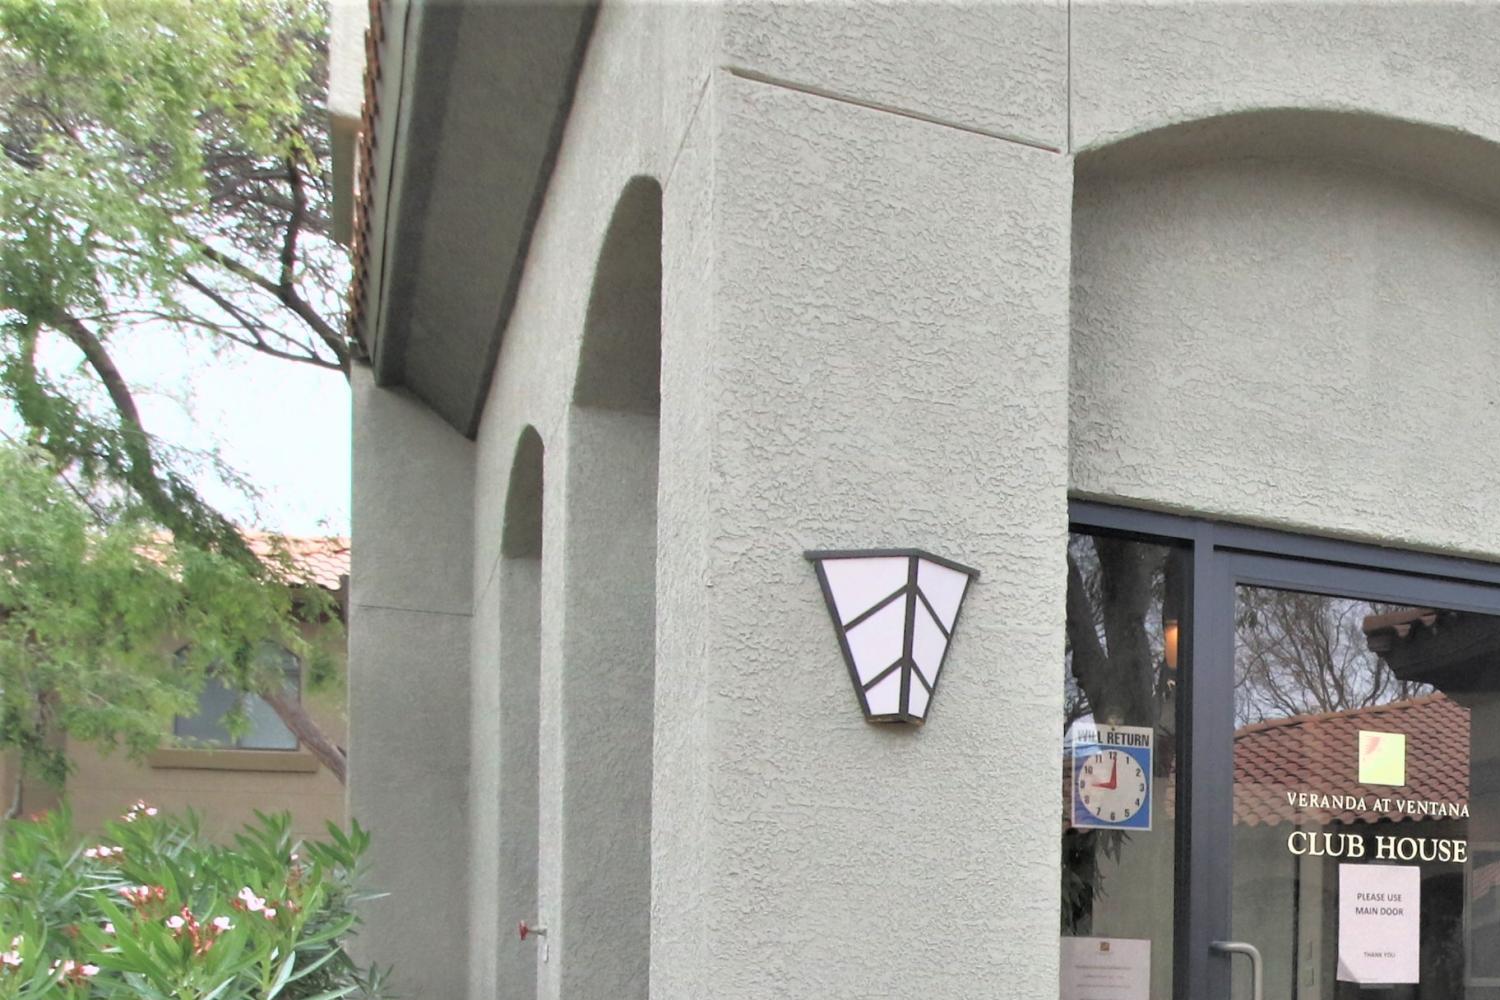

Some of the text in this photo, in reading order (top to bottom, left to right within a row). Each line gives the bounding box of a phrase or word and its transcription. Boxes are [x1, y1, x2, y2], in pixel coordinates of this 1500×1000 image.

[1107, 731, 1150, 747] RETURN
[1095, 754, 1102, 763] 11
[1109, 751, 1117, 761] 12
[1126, 756, 1130, 765] 1
[1084, 766, 1093, 775] 10
[1135, 768, 1141, 777] 2
[1080, 780, 1085, 789] 9
[1139, 784, 1145, 792] 3
[1084, 795, 1090, 804] 8
[1135, 798, 1140, 806] 4
[1287, 791, 1470, 818] VERANDA AT VENTANA
[1096, 807, 1101, 816] 7
[1124, 808, 1130, 817] 5
[1110, 812, 1116, 821] 6
[1287, 831, 1468, 863] CLUB HOUSE
[1356, 892, 1402, 903] PLEASE USE
[1355, 906, 1404, 917] MAIN DOOR
